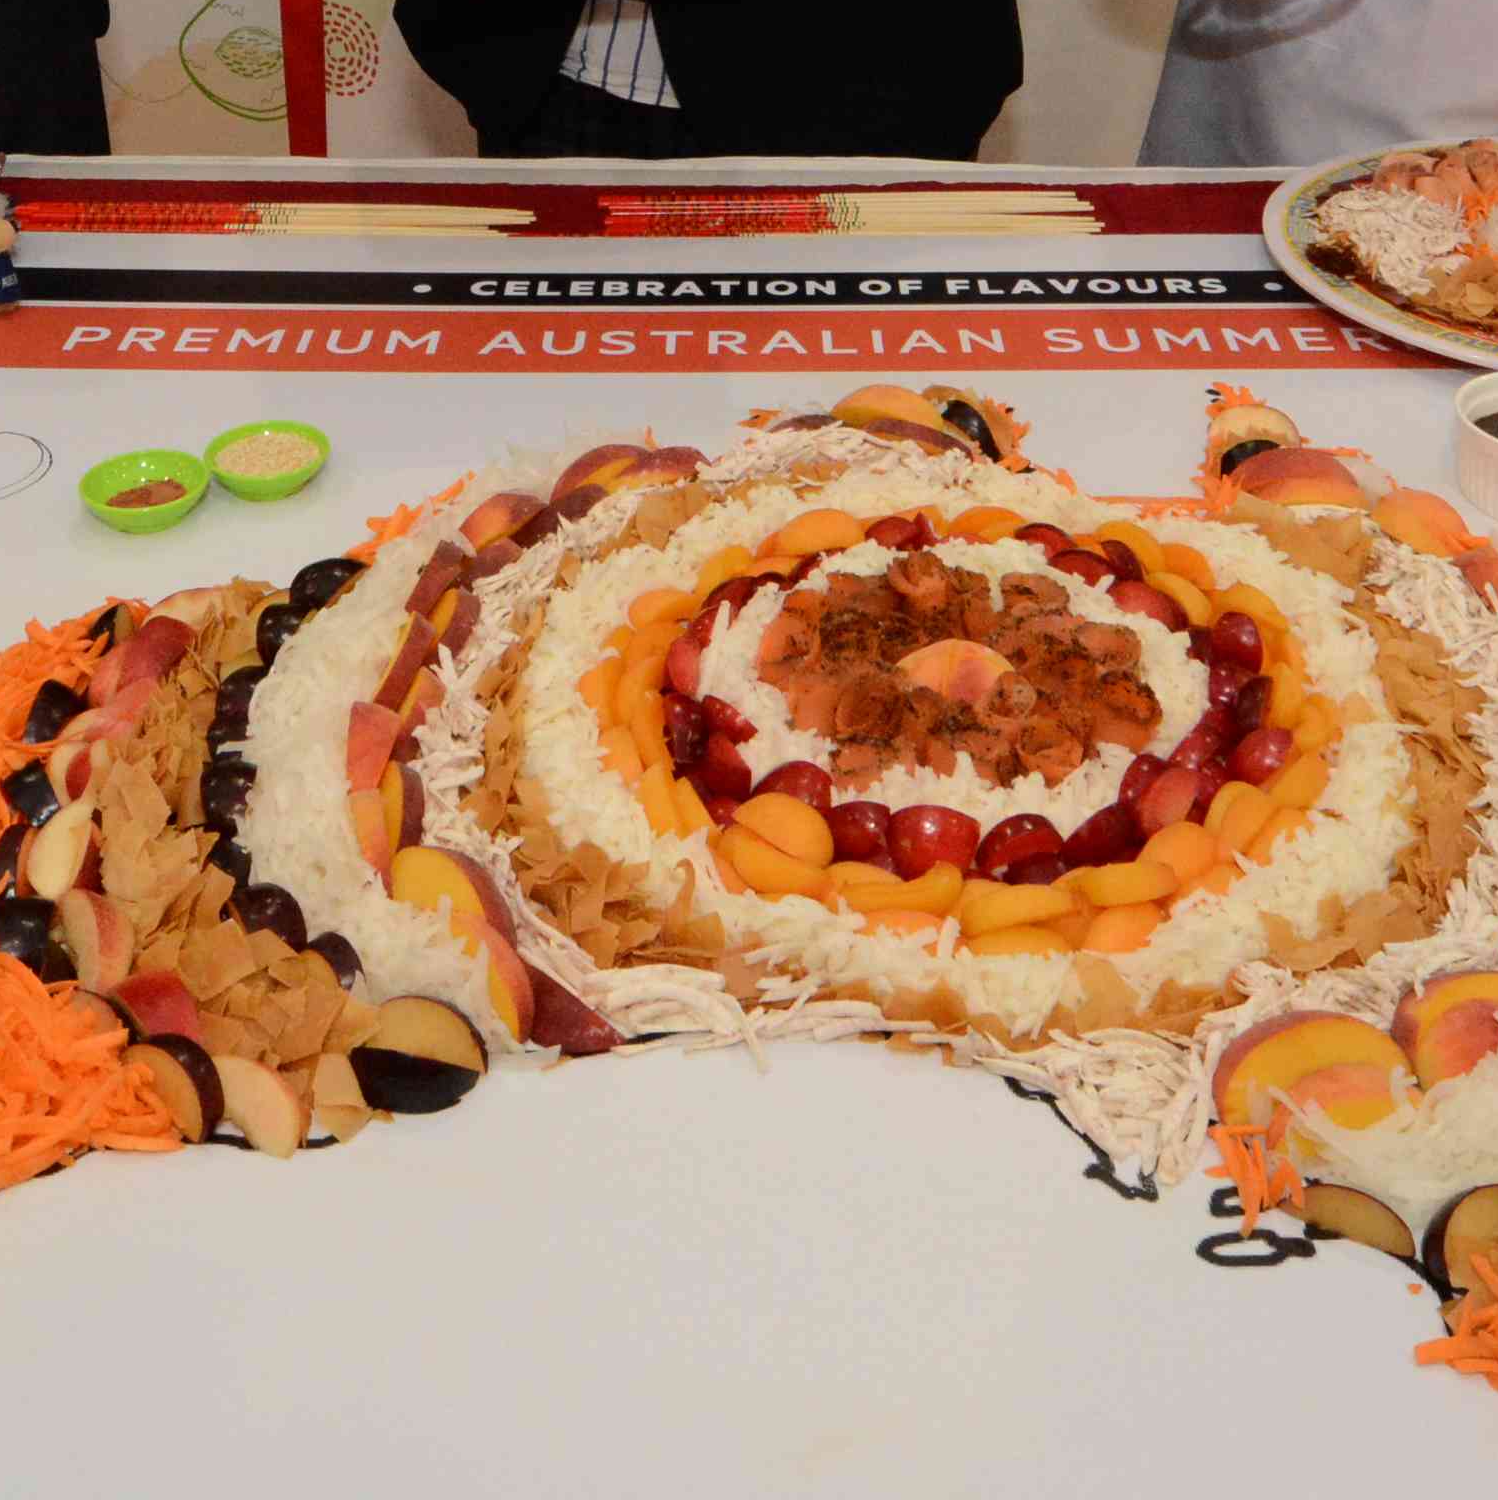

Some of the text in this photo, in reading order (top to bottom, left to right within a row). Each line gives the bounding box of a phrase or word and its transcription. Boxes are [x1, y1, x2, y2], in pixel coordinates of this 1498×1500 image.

[470, 276, 1227, 298] CELEBRATION OF FLAVOURS
[61, 325, 443, 356] PREMIUM
[478, 327, 1007, 357] AUSTRALIAN
